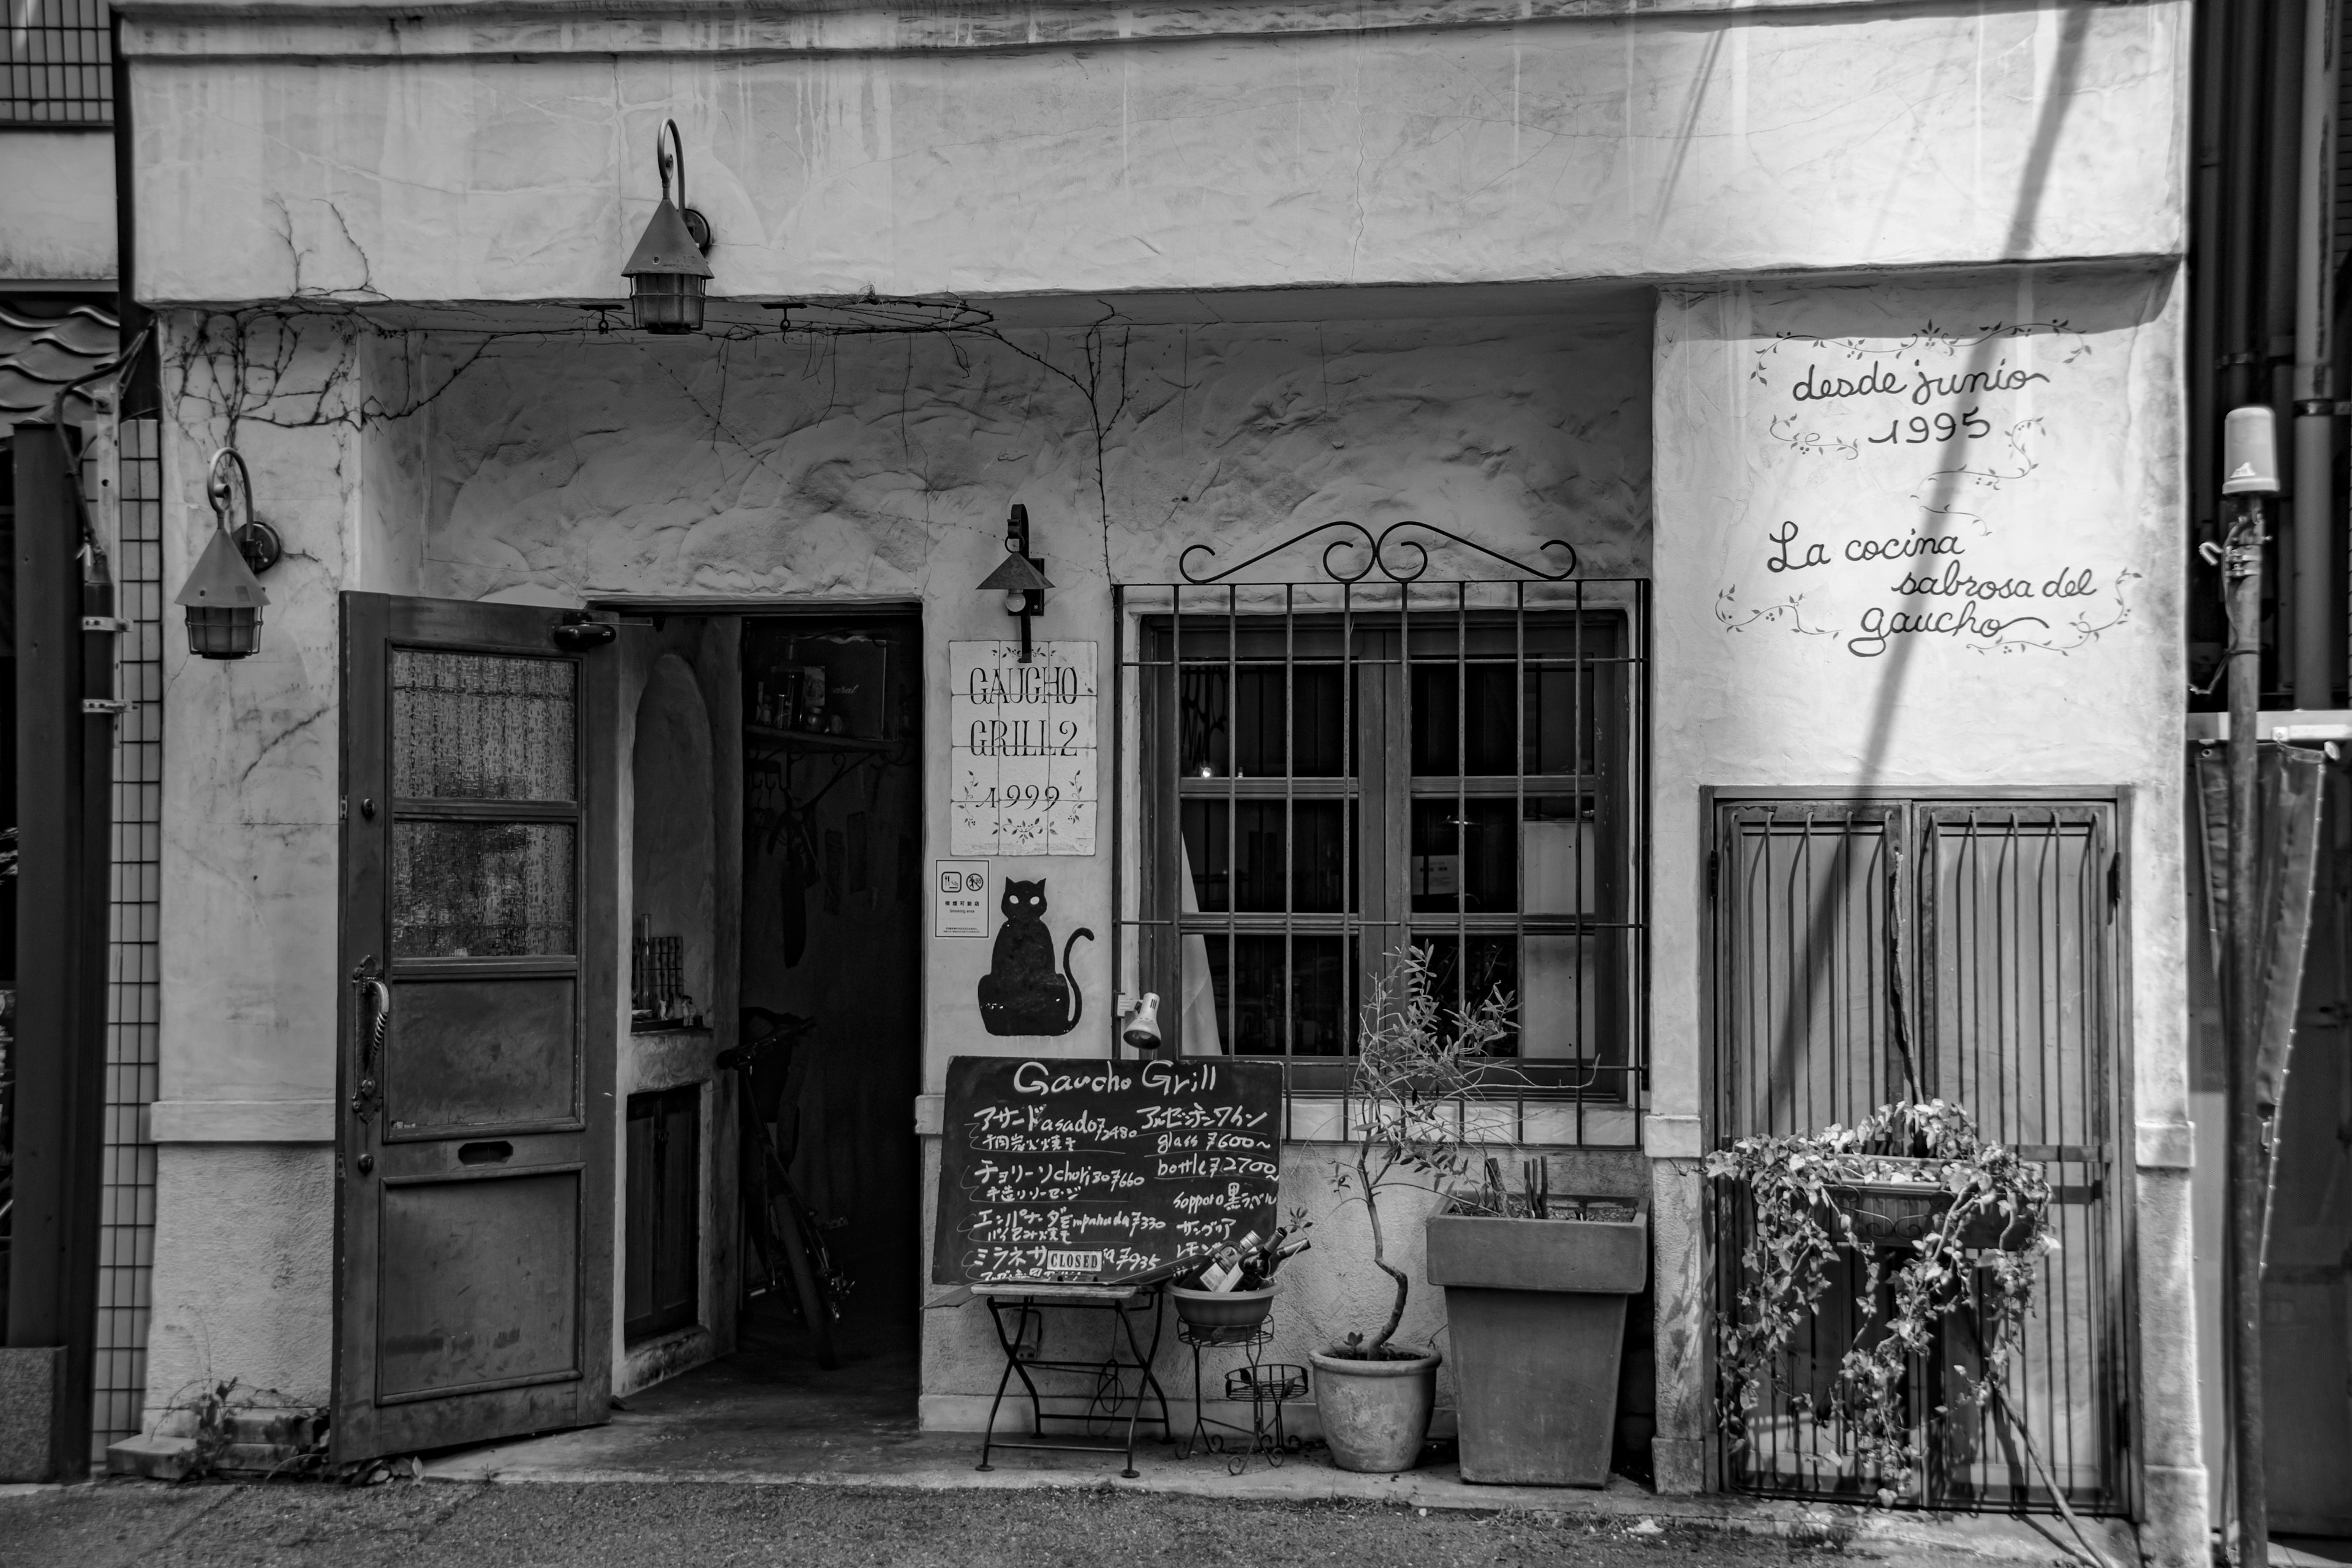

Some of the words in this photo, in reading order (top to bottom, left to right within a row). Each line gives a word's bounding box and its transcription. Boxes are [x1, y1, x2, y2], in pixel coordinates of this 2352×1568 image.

[1792, 360, 1907, 401] desde
[1908, 358, 2051, 406] junio
[1868, 406, 1991, 445] 1995
[1766, 521, 1831, 573] La
[1844, 527, 1966, 562] cocina
[1890, 559, 2036, 600] sabrosa
[2041, 567, 2097, 600] del
[1847, 600, 2050, 658] gaucho
[969, 666, 1079, 706] GAUCHO
[975, 785, 1061, 813] 1999
[1013, 1061, 1133, 1095] Gaucho
[1141, 1060, 1216, 1096] Grill
[1041, 1109, 1097, 1133] asado
[1156, 1131, 1199, 1155] glass
[1157, 1152, 1207, 1177] bottle
[1050, 1253, 1099, 1269] CLOSED
